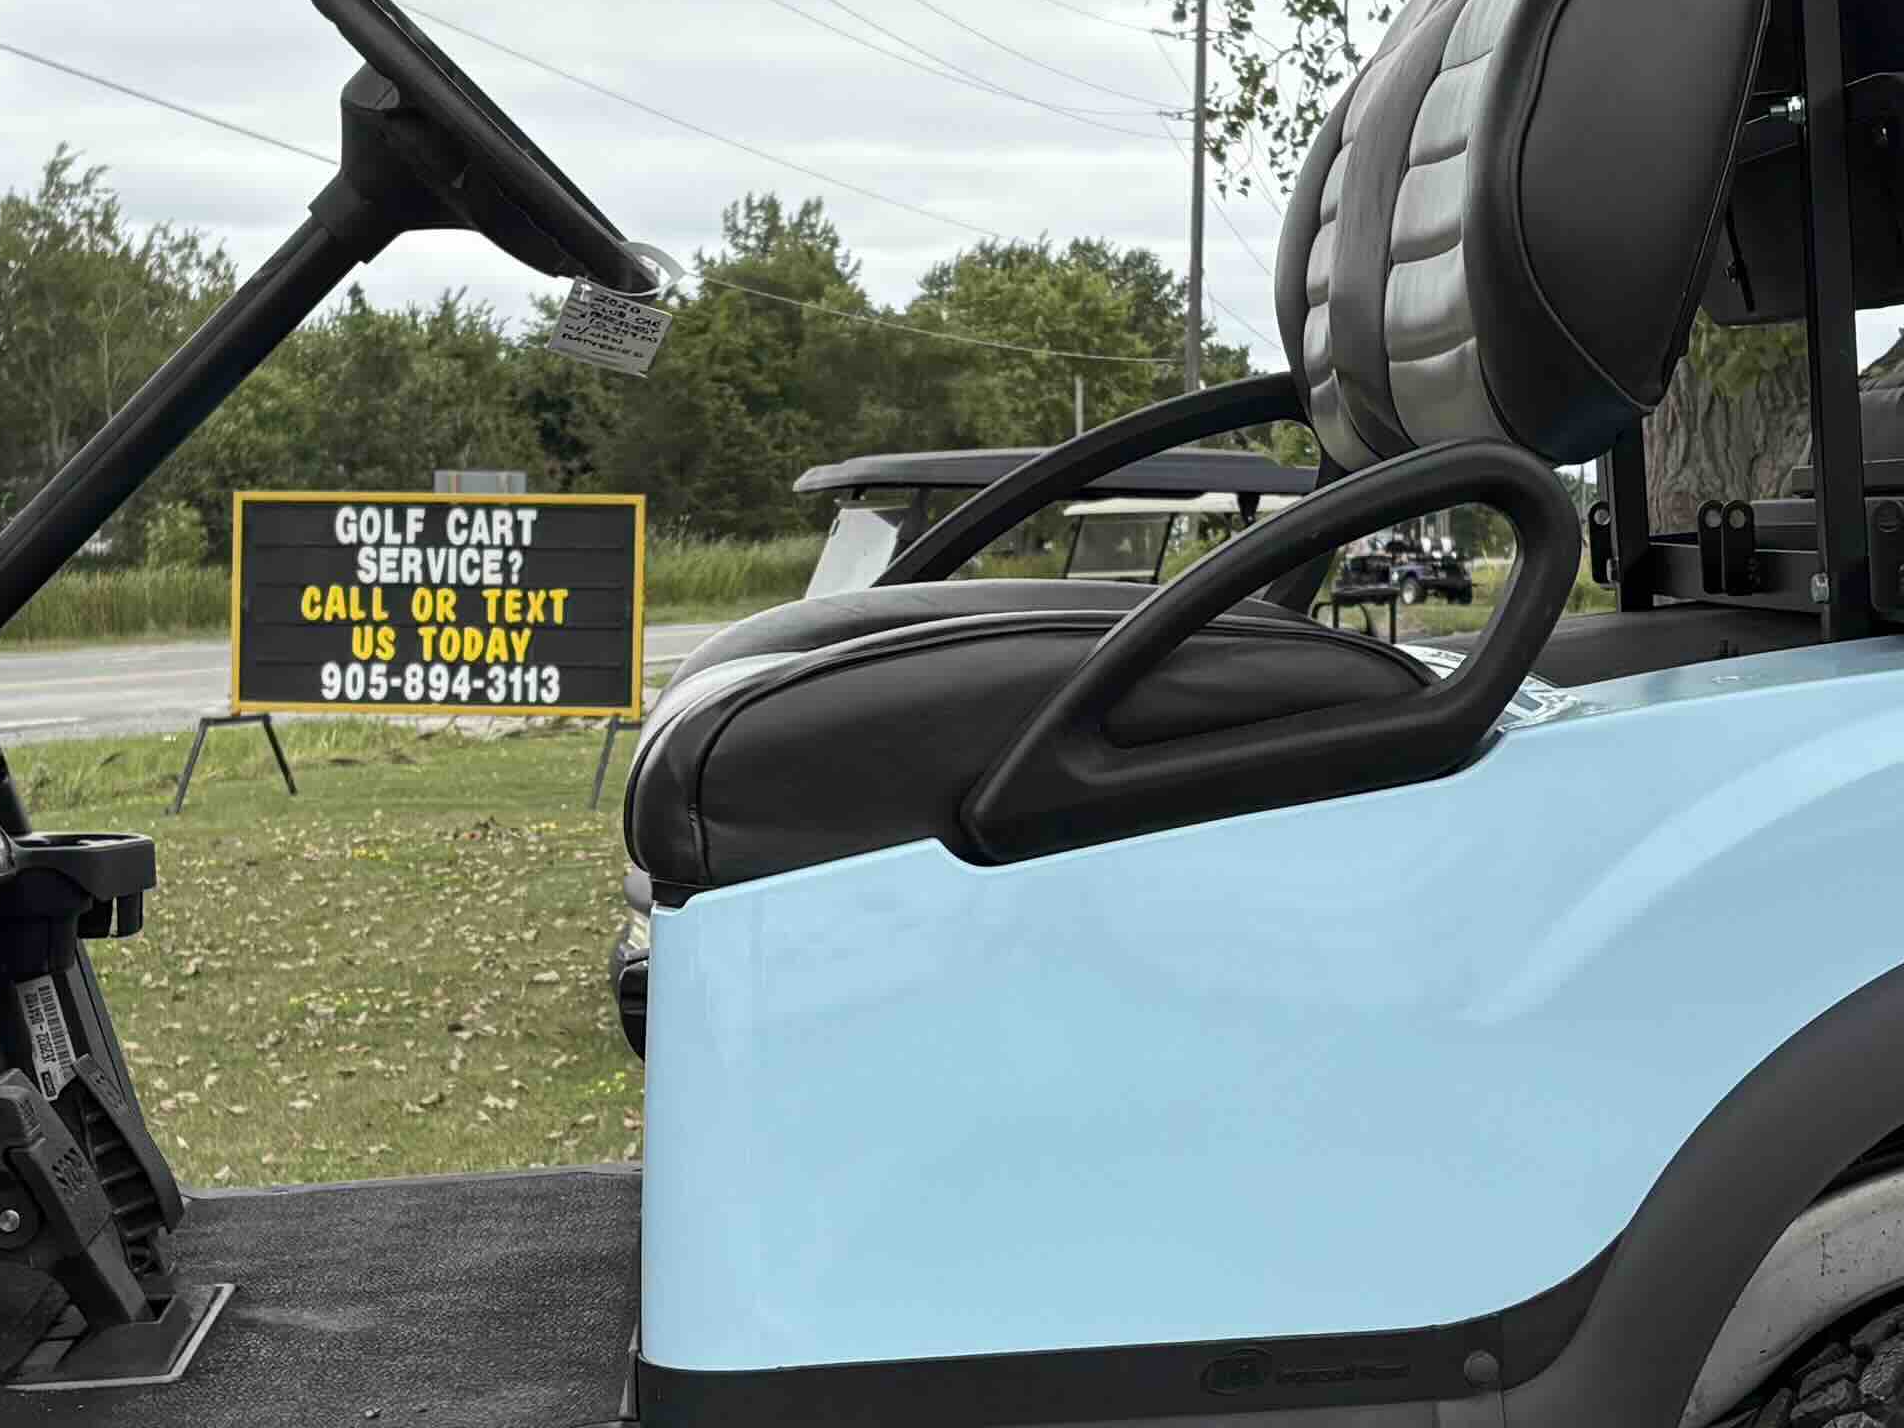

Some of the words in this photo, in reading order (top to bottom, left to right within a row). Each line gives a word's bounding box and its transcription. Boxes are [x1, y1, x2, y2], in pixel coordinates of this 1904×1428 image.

[334, 507, 425, 546] GOLF
[446, 507, 538, 546] CART
[356, 547, 524, 585] SERVICE?
[300, 585, 390, 621] CALL
[411, 588, 457, 623] OR
[482, 588, 569, 625] TEXT
[351, 626, 396, 661] US
[417, 627, 533, 664] TODAY
[320, 661, 561, 703] 905-894-3113
